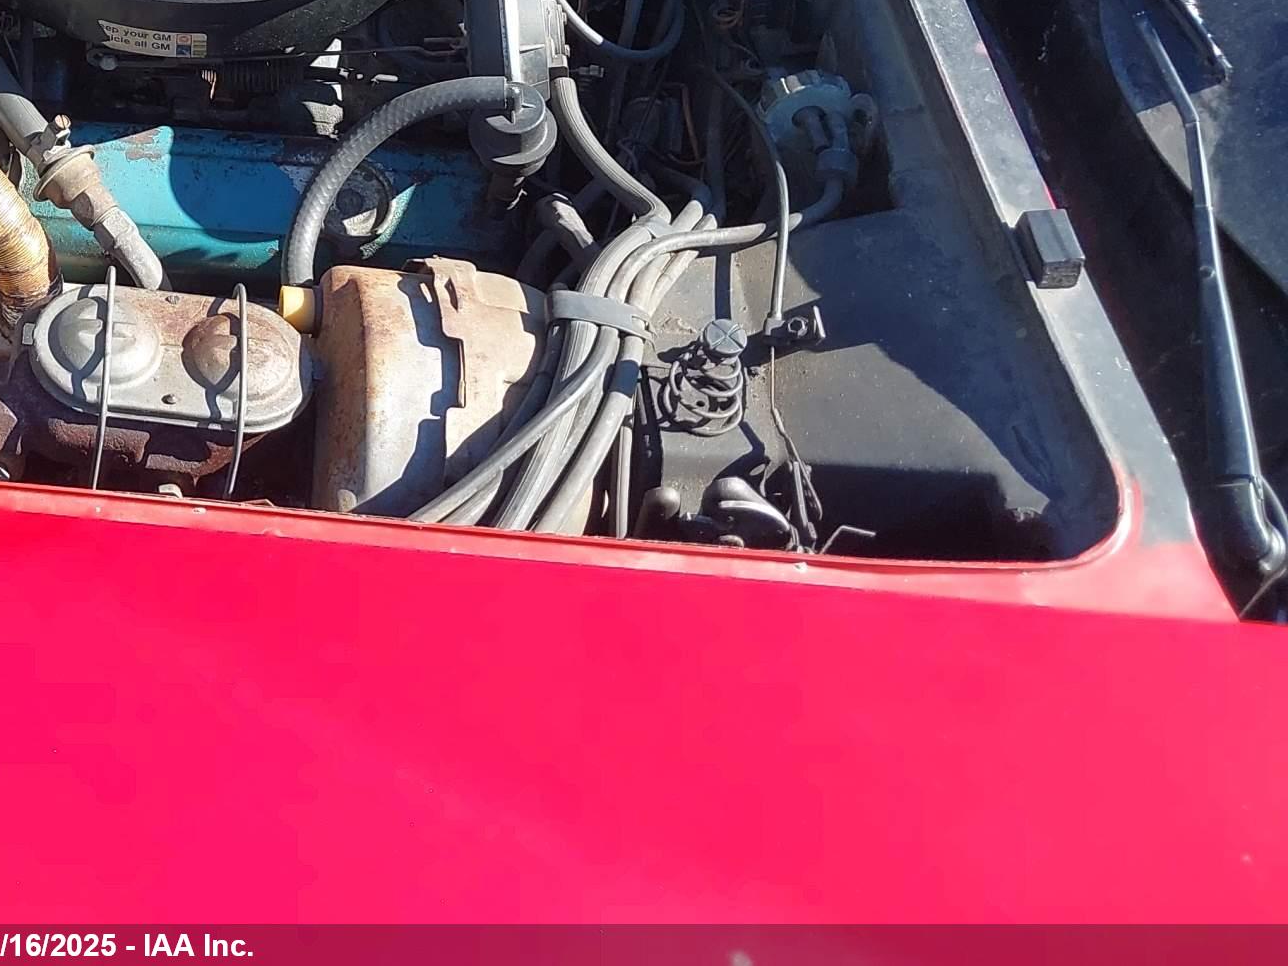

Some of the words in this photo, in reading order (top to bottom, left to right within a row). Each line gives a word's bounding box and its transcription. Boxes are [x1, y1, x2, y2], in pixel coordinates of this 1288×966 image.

[123, 29, 149, 39] your
[152, 33, 172, 42] GM
[134, 40, 147, 48] all
[151, 42, 171, 51] GM
